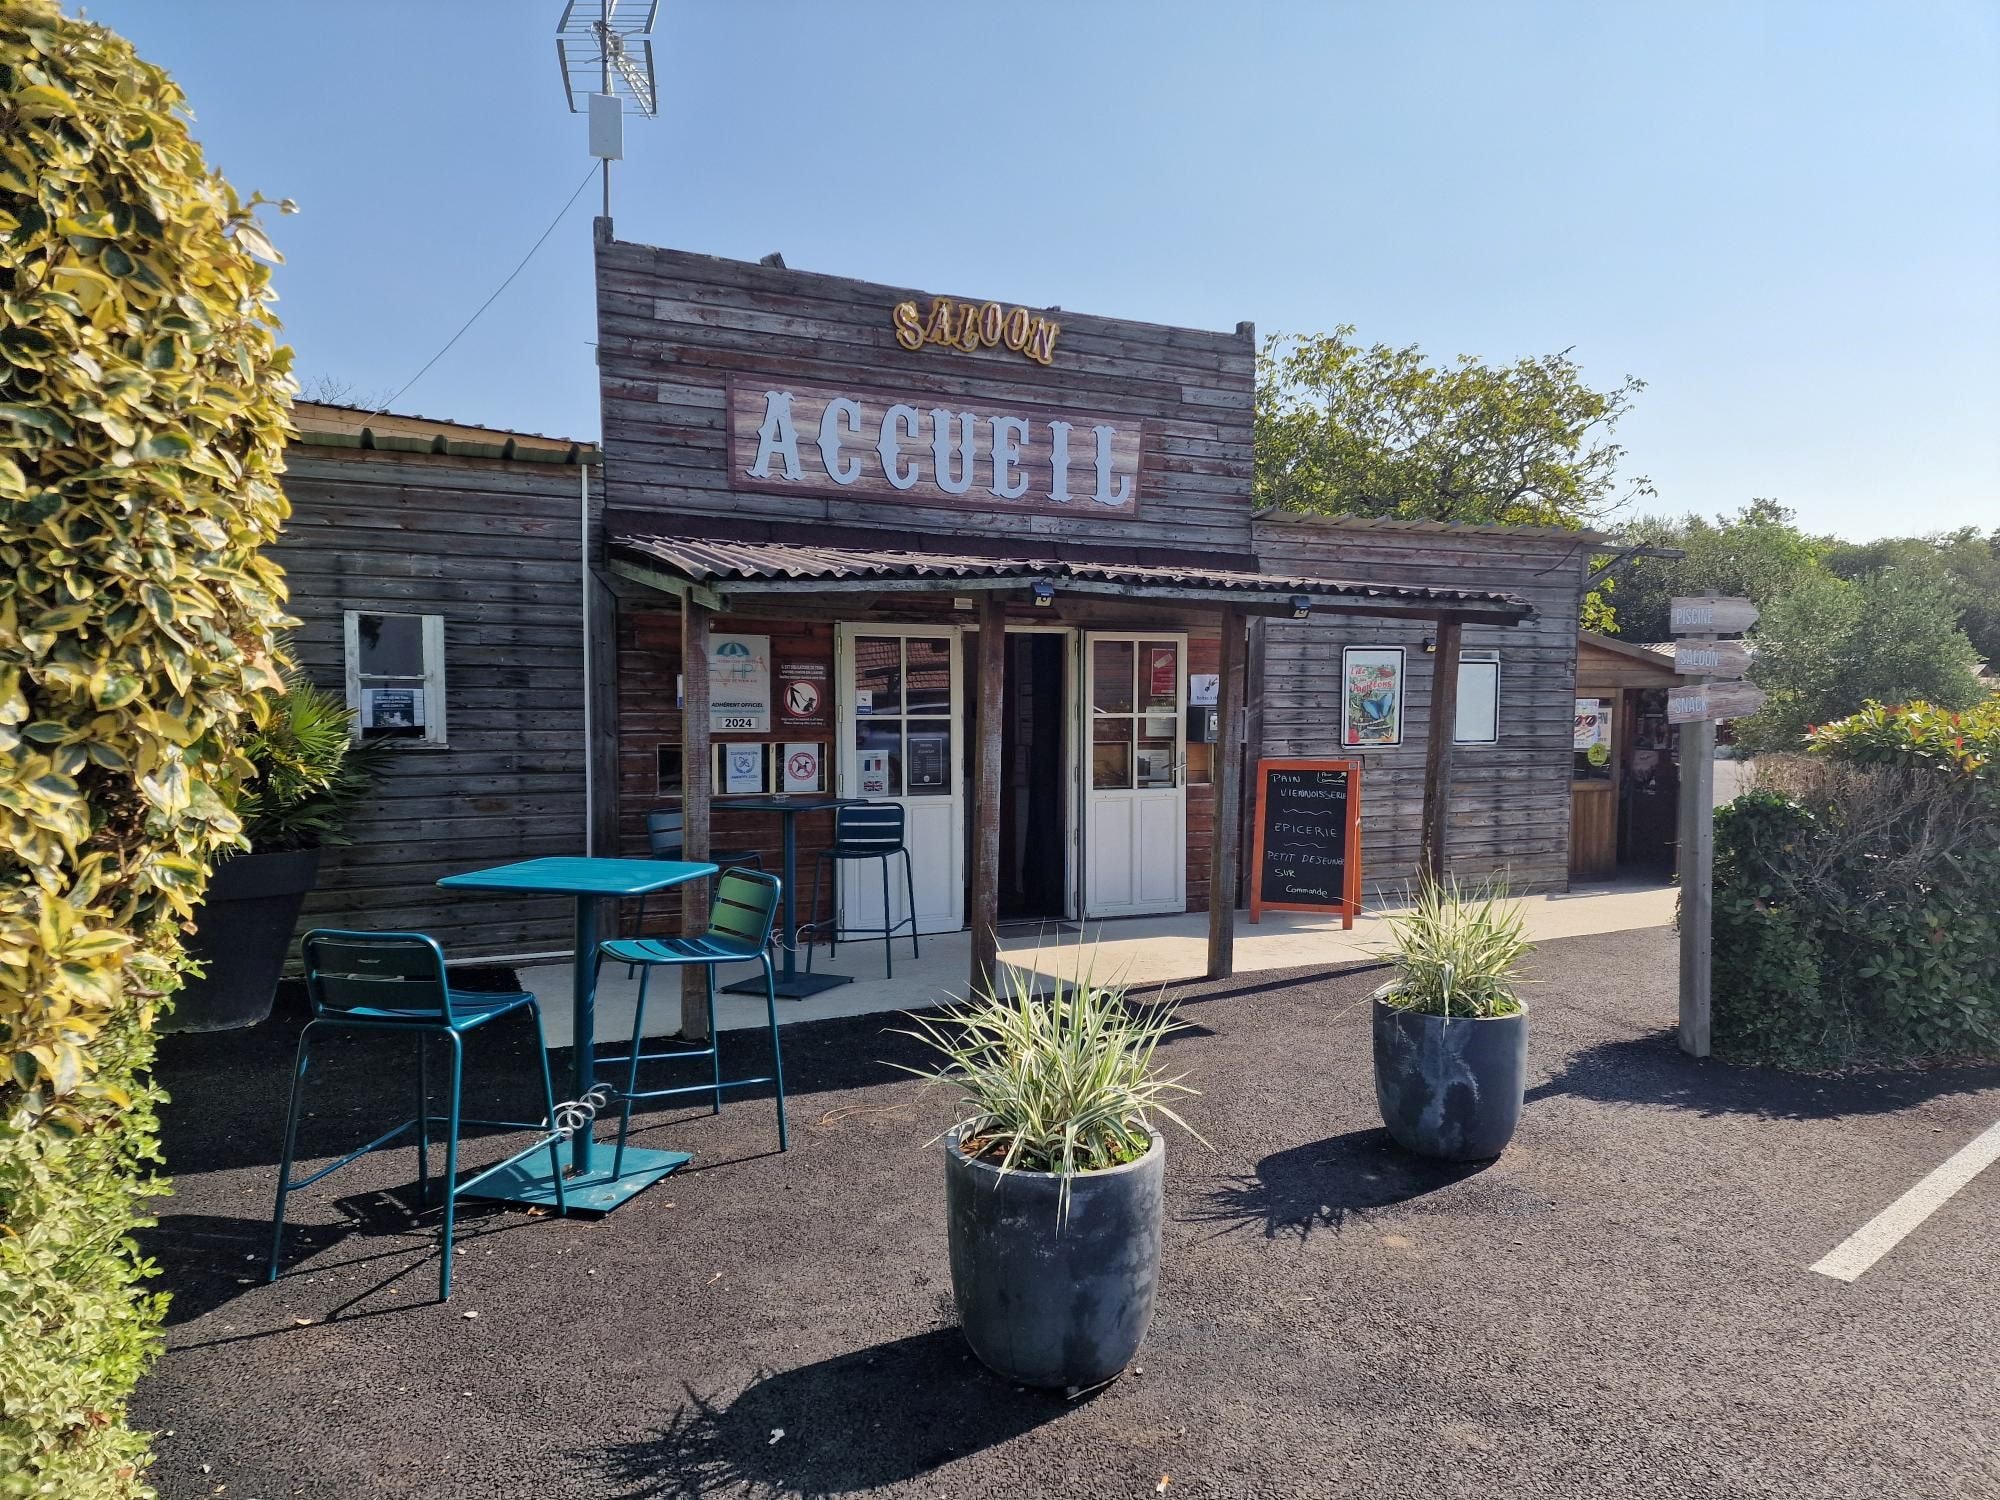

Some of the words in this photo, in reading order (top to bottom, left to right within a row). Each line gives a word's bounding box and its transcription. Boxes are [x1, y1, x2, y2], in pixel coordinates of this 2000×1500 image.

[893, 298, 1059, 365] SALOON
[745, 391, 1131, 506] ACCUEIL
[1676, 607, 1713, 624] PISCINE
[1680, 649, 1719, 666] SALOON
[1674, 695, 1708, 713] SNACK
[725, 719, 752, 727] 2024
[1270, 773, 1301, 783] PAIN
[1267, 850, 1296, 862] PETIT
[1274, 868, 1296, 878] SUR
[1286, 884, 1329, 898] Commande
